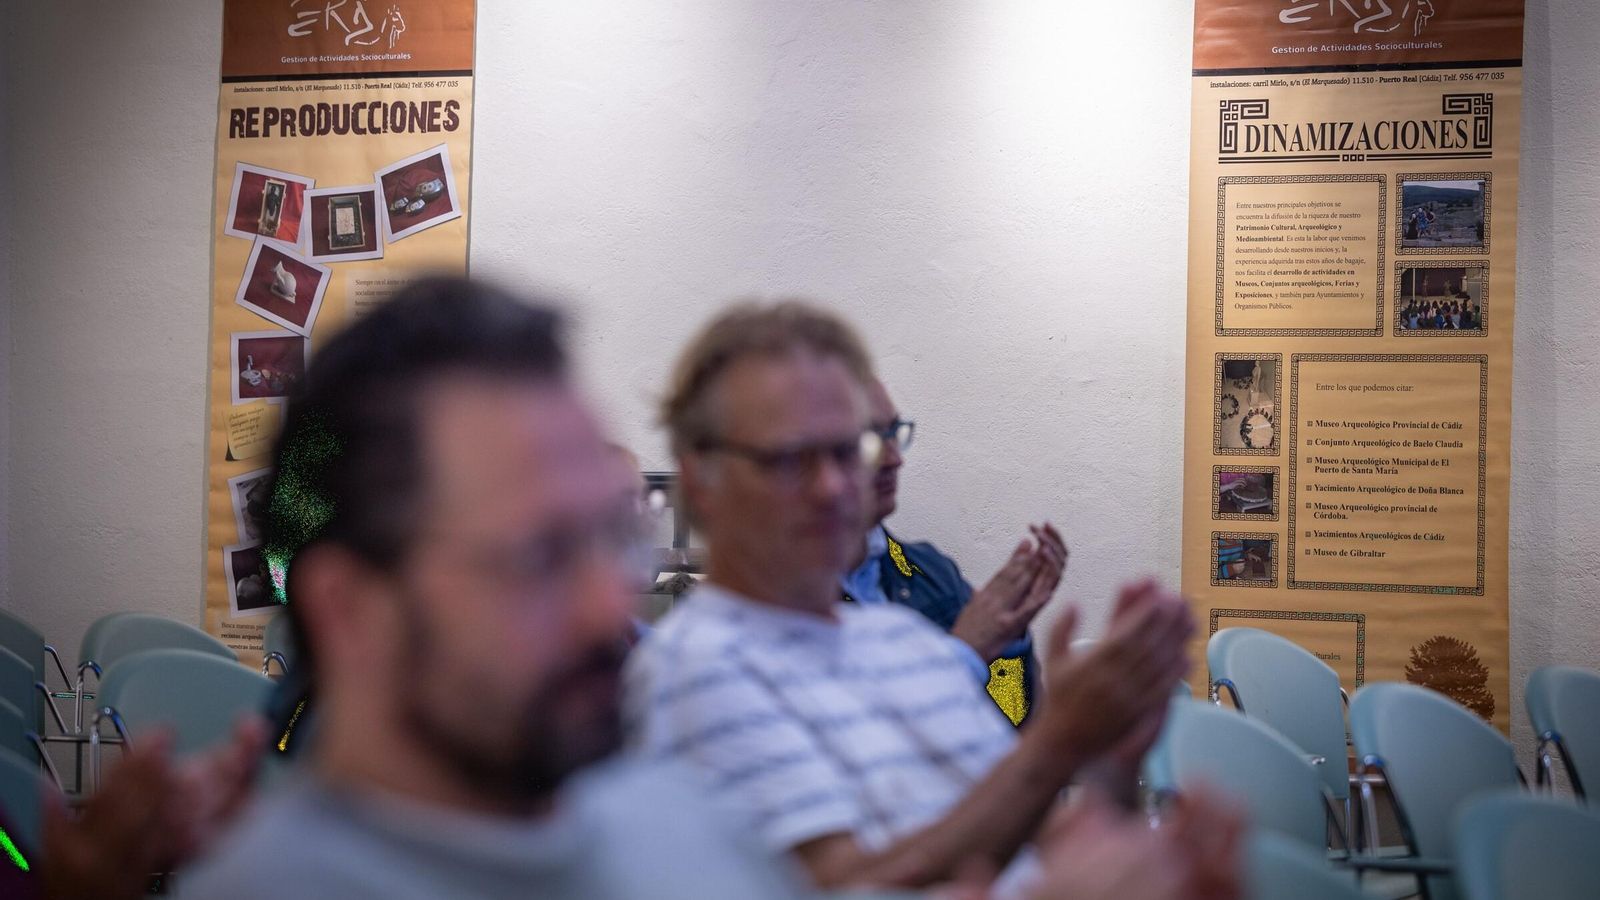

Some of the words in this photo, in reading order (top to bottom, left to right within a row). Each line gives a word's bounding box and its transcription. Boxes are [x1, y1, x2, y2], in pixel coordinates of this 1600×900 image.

[1321, 43, 1372, 52] Actividades
[1375, 41, 1442, 50] Socioculturales
[229, 100, 460, 139] REPRODUCCIONES
[1245, 119, 1468, 153] DINAMIZACIONES
[1363, 384, 1394, 393] podemos
[1341, 421, 1390, 430] Arqueológico
[1315, 439, 1350, 447] Conjunto
[1352, 439, 1400, 448] Arqueológico
[1341, 458, 1389, 466] Arqueológico
[1392, 458, 1429, 467] Municipal
[1375, 466, 1398, 474] María
[1357, 485, 1406, 494] Arqueológico
[1440, 487, 1464, 495] Blanca
[1340, 503, 1388, 512] Arqueológico
[1391, 504, 1427, 512] provincial
[1313, 512, 1348, 520] Córdoba.
[1359, 531, 1411, 540] Arqueológicos
[1423, 532, 1445, 541] Cádiz
[1350, 549, 1385, 558] Gibraltar
